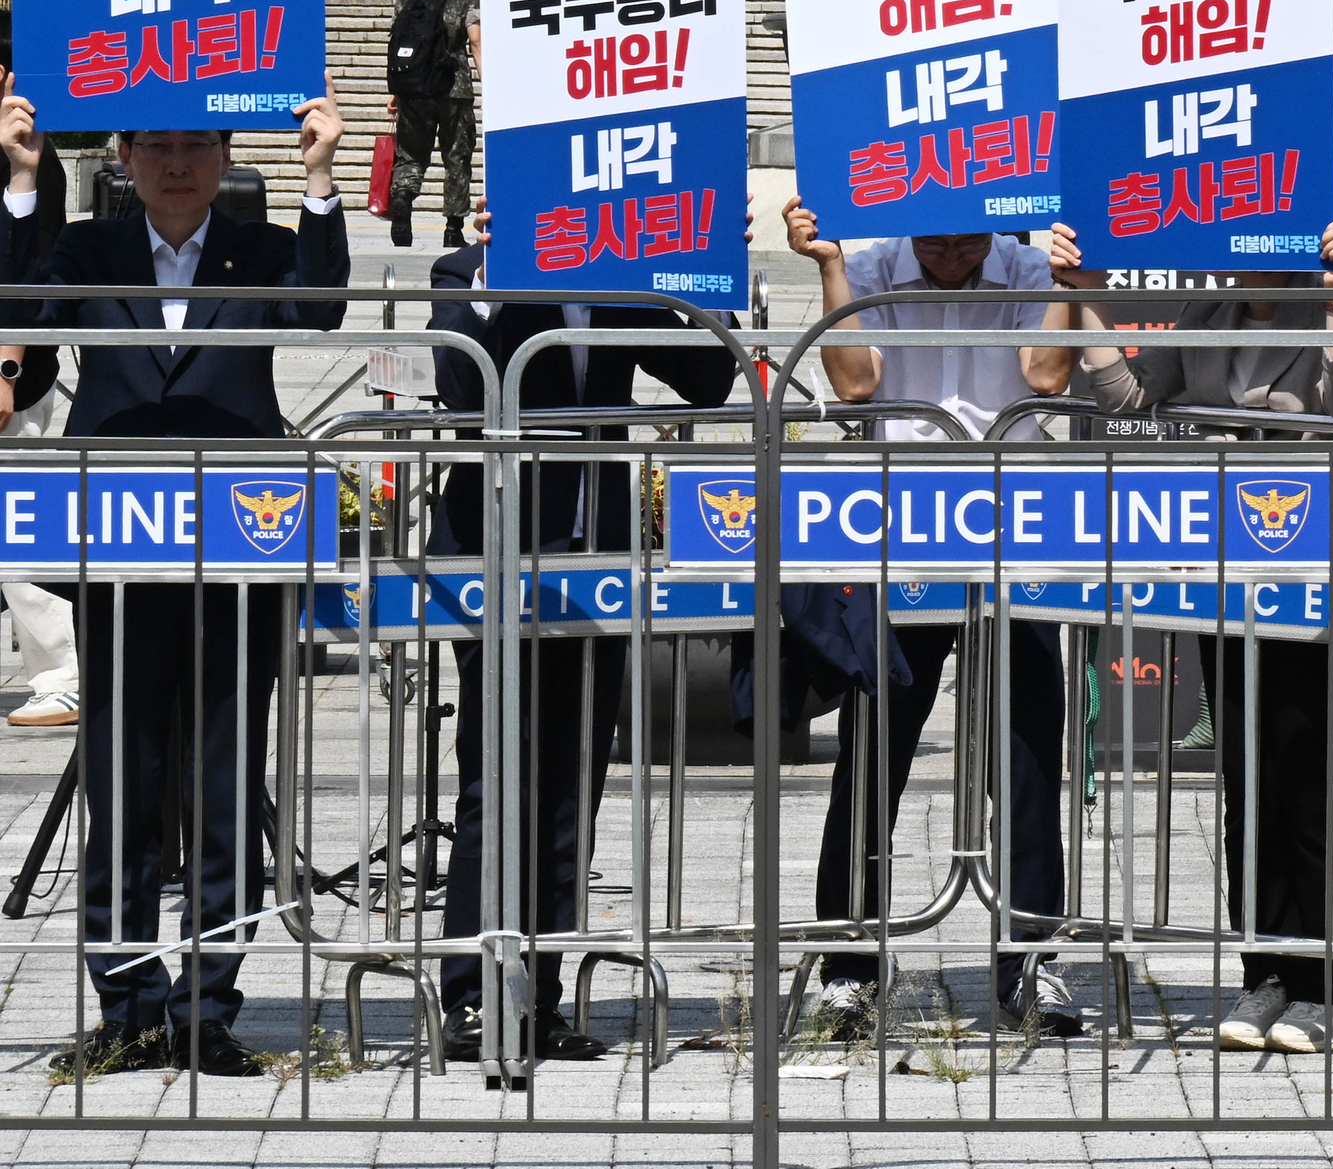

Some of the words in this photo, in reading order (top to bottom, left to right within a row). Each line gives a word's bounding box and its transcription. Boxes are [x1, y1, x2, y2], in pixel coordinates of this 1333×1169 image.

[67, 6, 284, 97] 총사퇴!
[567, 28, 689, 100] 해임!
[886, 50, 1007, 127] 내각
[1146, 84, 1257, 157] 내각
[571, 122, 676, 195] 내각
[849, 112, 1055, 206] 총사퇴!
[1108, 150, 1299, 236] 총사퇴!
[534, 188, 715, 276] 총사퇴!
[1231, 235, 1320, 254] 더불어민주당
[653, 273, 735, 291] 더불어민주당
[68, 492, 195, 543] LINE
[253, 531, 284, 539] POLICE
[720, 529, 751, 538] POLICE
[799, 490, 1042, 543] POLICE
[1075, 491, 1209, 543] LINE
[1258, 529, 1289, 538] POLICE
[412, 577, 668, 618] POLICE
